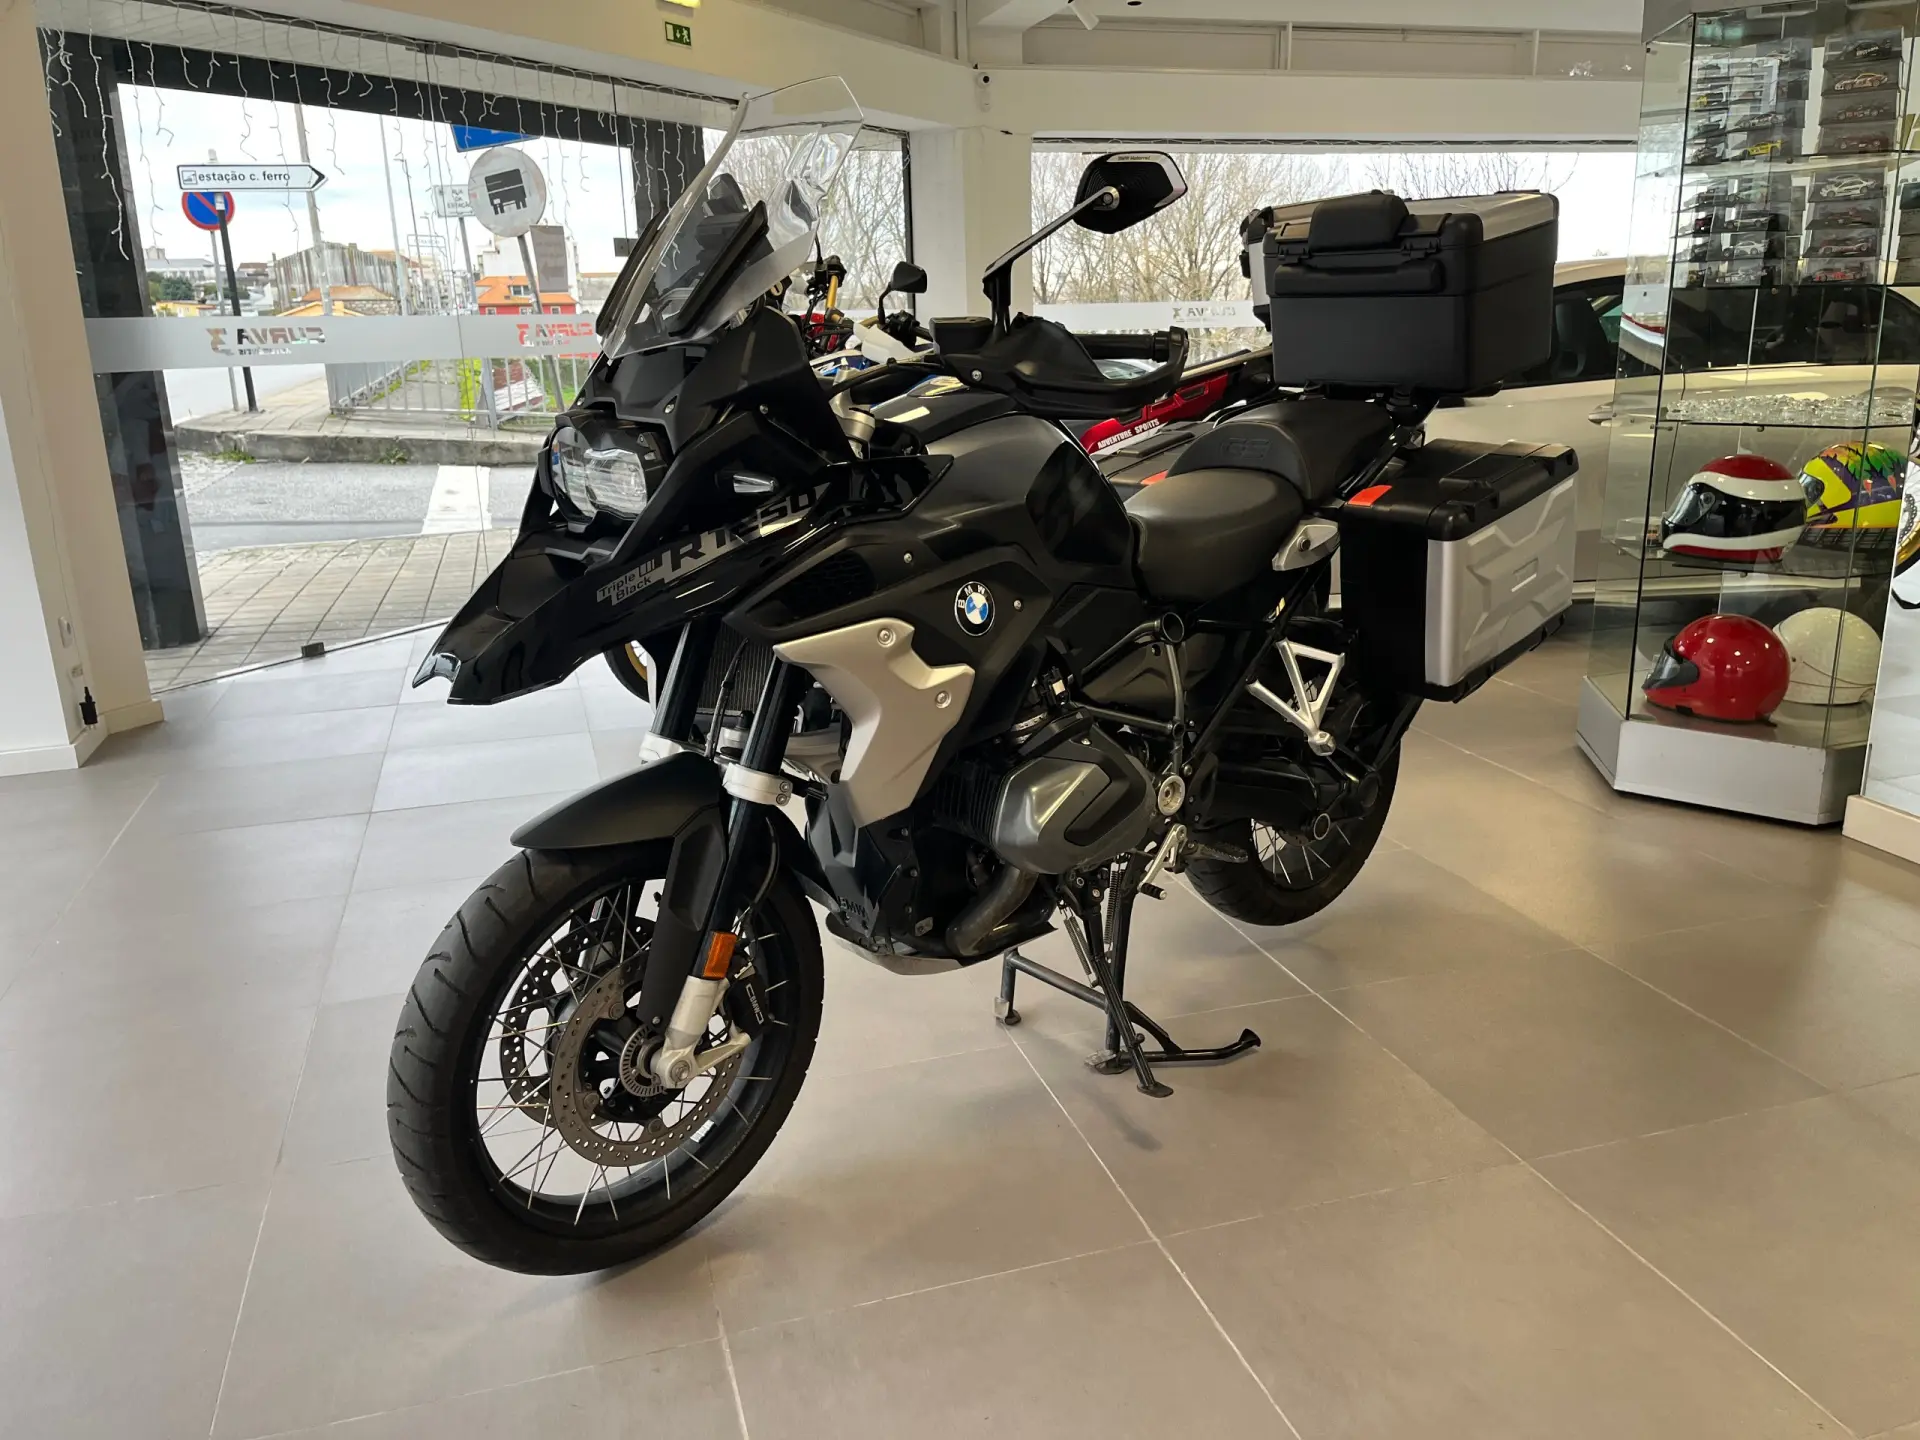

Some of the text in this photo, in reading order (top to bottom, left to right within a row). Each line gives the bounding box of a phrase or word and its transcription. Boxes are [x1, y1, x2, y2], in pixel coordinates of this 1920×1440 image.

[198, 171, 291, 183] estação c. ferro
[1097, 418, 1160, 450] ADVENTURE SPORTS
[600, 572, 637, 597] Triple
[615, 576, 652, 602] Black
[957, 584, 986, 609] BMW
[838, 896, 867, 919] BMW
